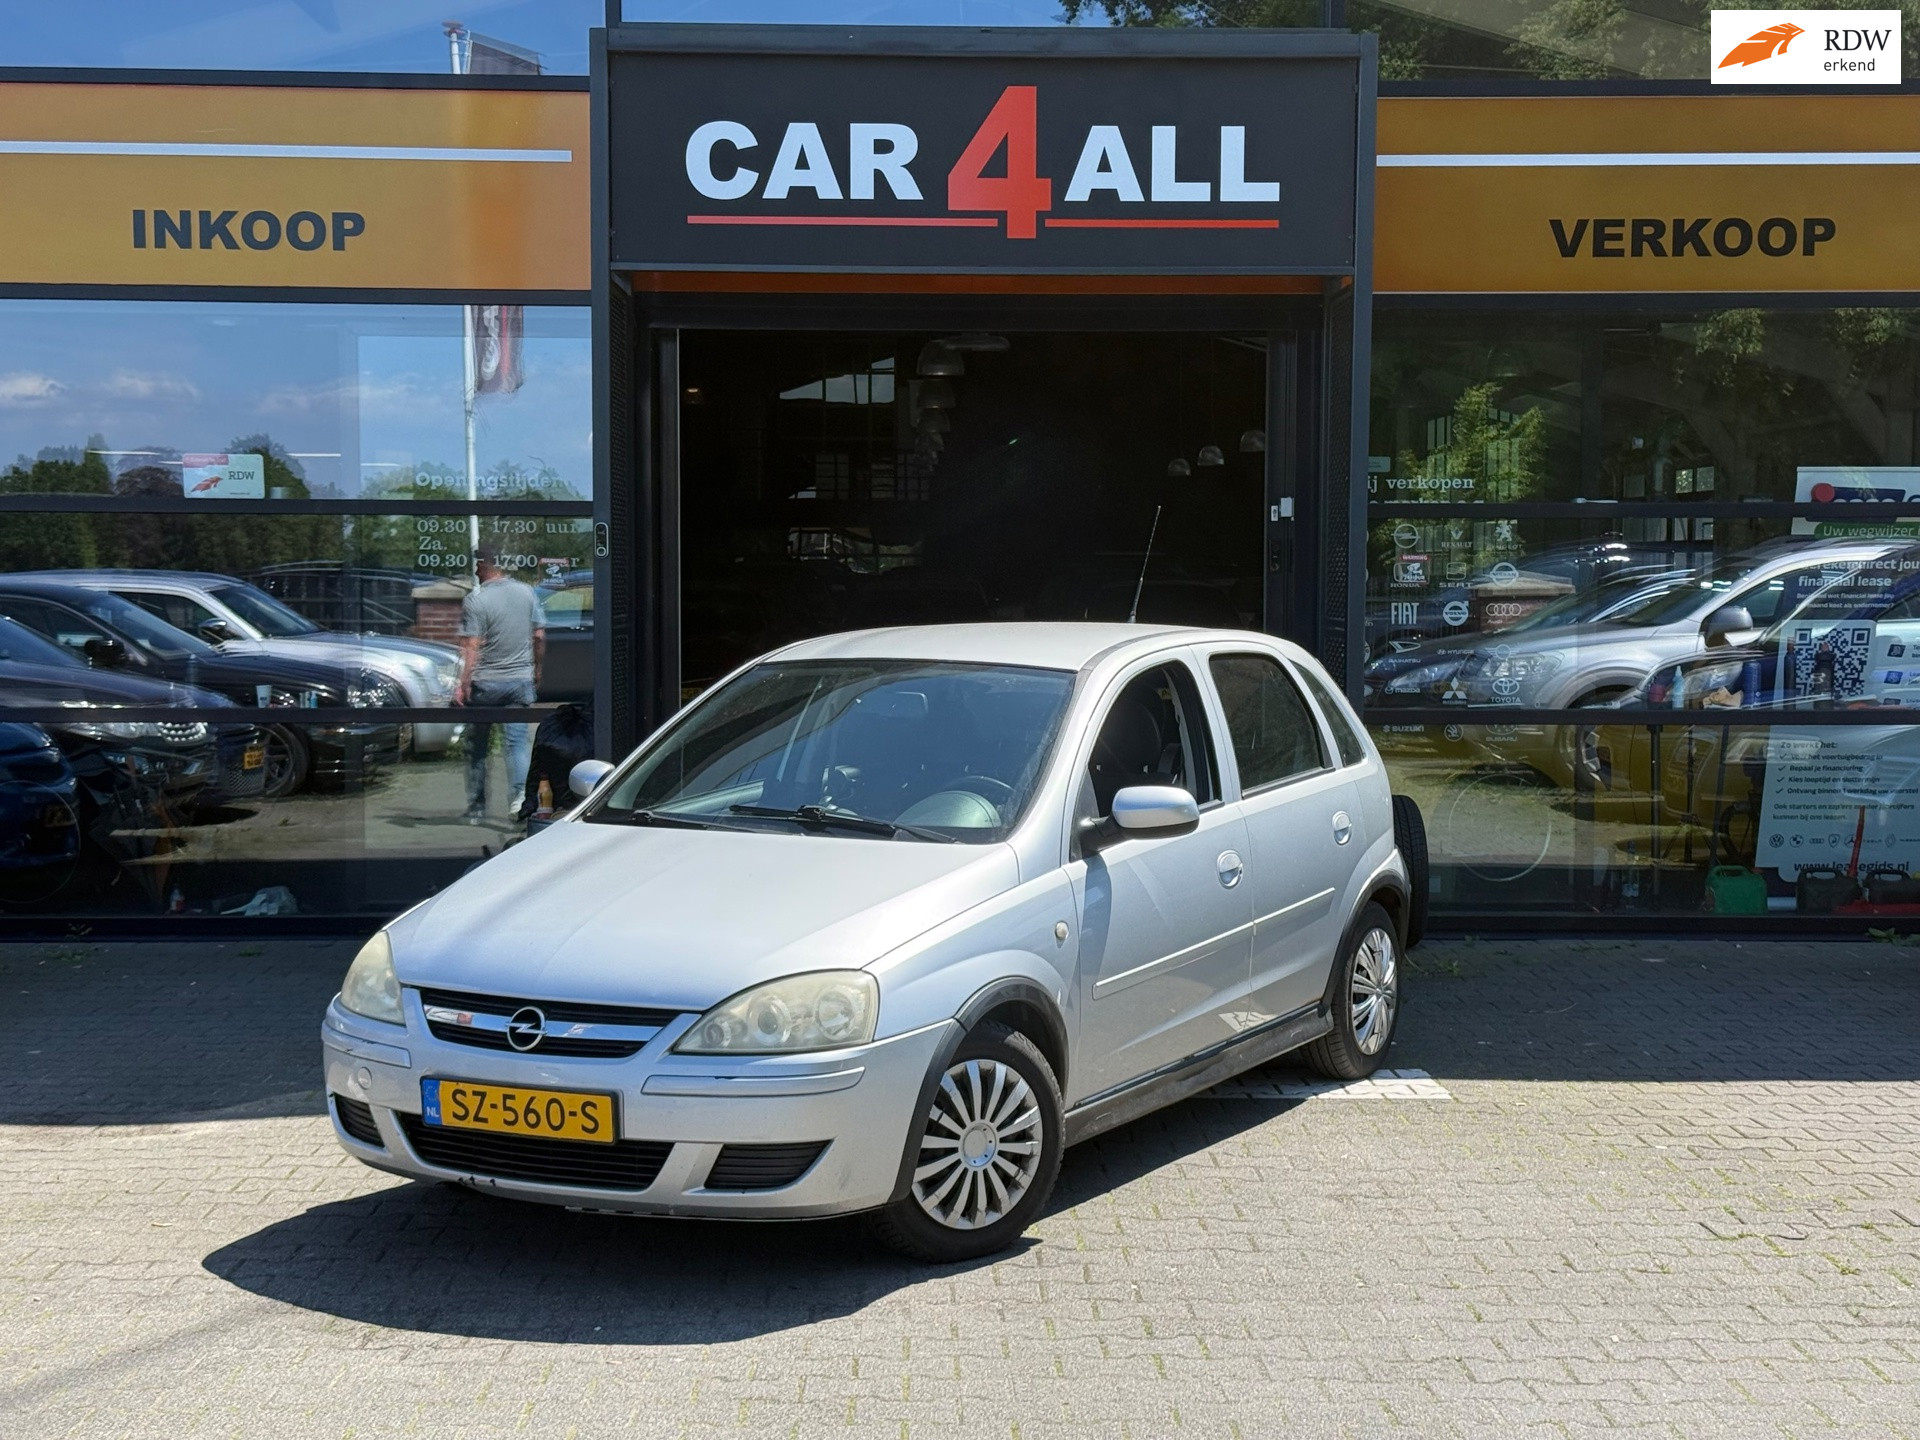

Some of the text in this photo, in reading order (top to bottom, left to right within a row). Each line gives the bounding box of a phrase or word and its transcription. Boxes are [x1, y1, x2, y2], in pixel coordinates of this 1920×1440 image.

[685, 85, 1280, 239] CAR 4 ALL
[133, 210, 365, 251] INKOOP
[1549, 217, 1836, 257] VERKOOP
[228, 471, 255, 480] RDW
[415, 472, 568, 490] Openngstijden
[1386, 475, 1474, 493] verkopen
[417, 520, 467, 533] 09.30
[493, 520, 537, 533] 17.30
[546, 522, 579, 533] uur
[1823, 526, 1844, 536] Uw
[1848, 526, 1914, 539] wegwijzer
[419, 537, 447, 551] Za.
[418, 554, 468, 568] 09.30
[494, 555, 538, 568] 17.00
[1799, 576, 1892, 587] finanial lease
[1391, 602, 1420, 625] FIAT
[1794, 861, 1910, 872] wwwleaegidspl
[427, 1107, 439, 1118] NL
[451, 1089, 600, 1135] SZ-560-S
